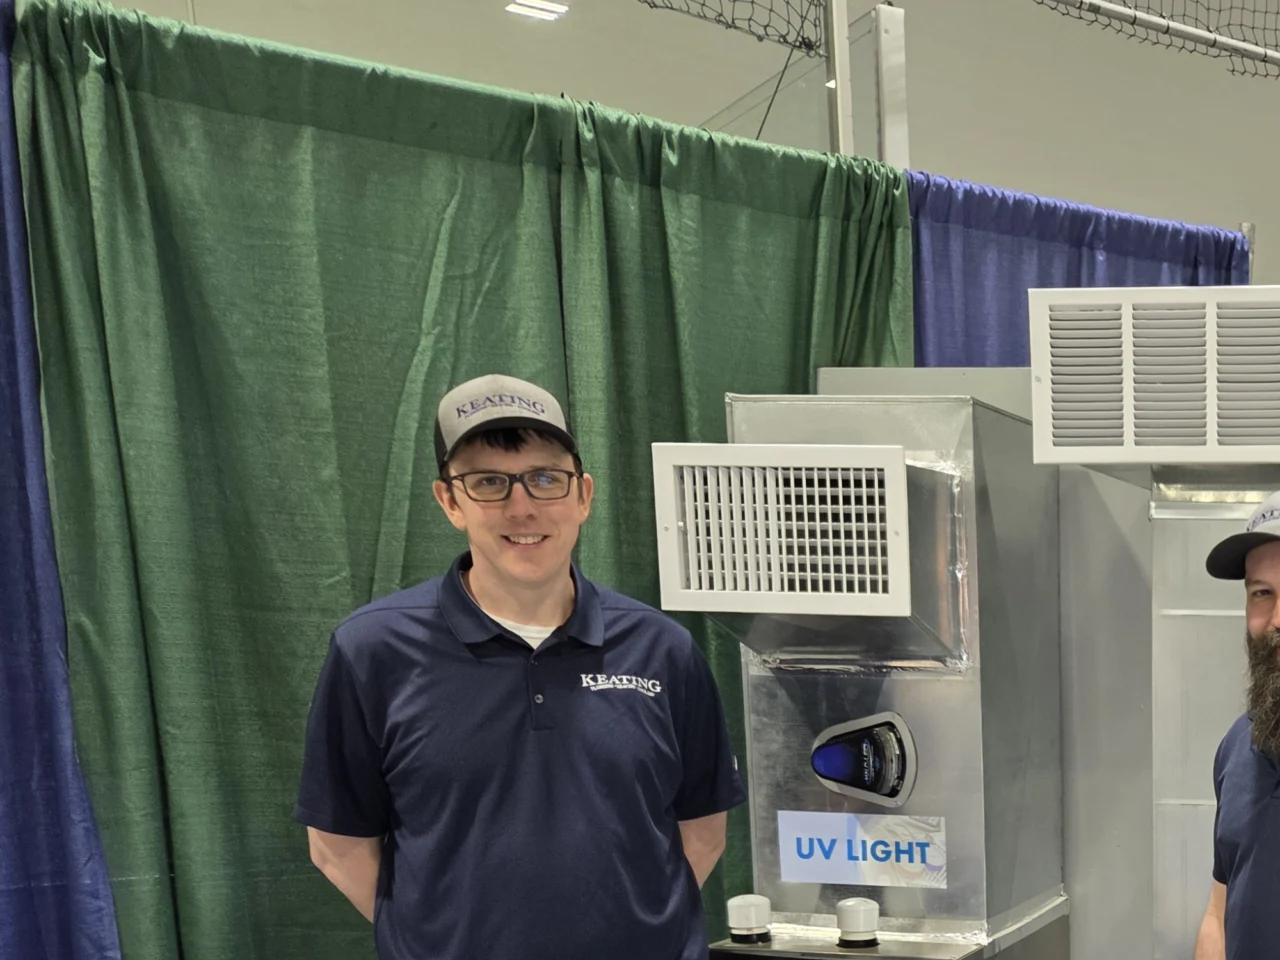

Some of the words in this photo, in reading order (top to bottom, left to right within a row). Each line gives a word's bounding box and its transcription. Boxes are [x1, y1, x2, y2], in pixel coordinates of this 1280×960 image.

[456, 394, 545, 418] KEATING
[580, 674, 662, 693] KEATING
[795, 837, 838, 862] UV
[846, 839, 930, 864] LIGHT
